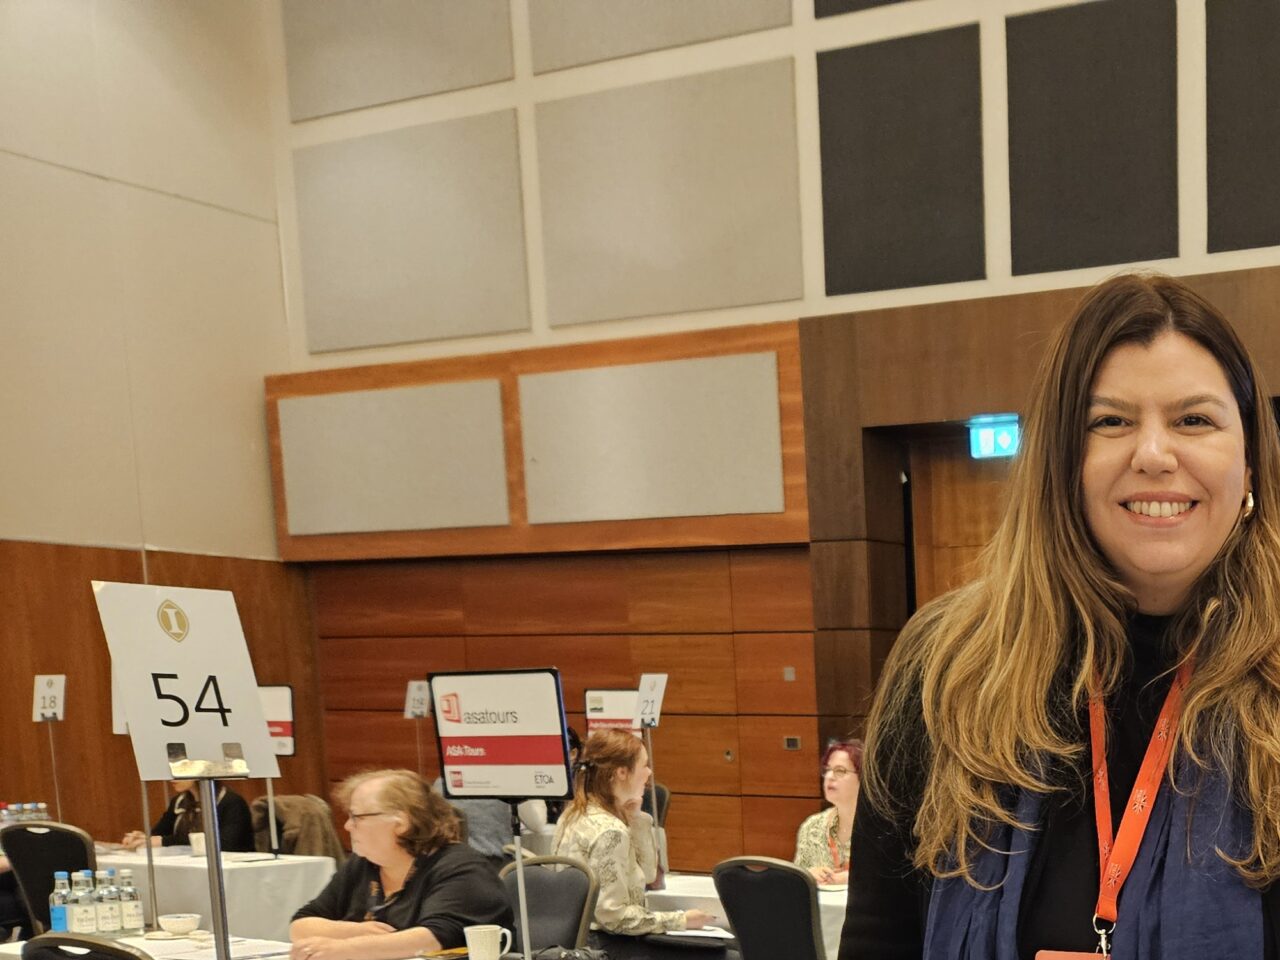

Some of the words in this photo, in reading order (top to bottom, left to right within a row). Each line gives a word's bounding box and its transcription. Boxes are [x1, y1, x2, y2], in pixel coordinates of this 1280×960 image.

[41, 695, 57, 709] 18
[151, 673, 232, 727] 54
[641, 700, 655, 715] 21
[463, 708, 518, 724] asatours
[534, 774, 555, 785] ETOA
